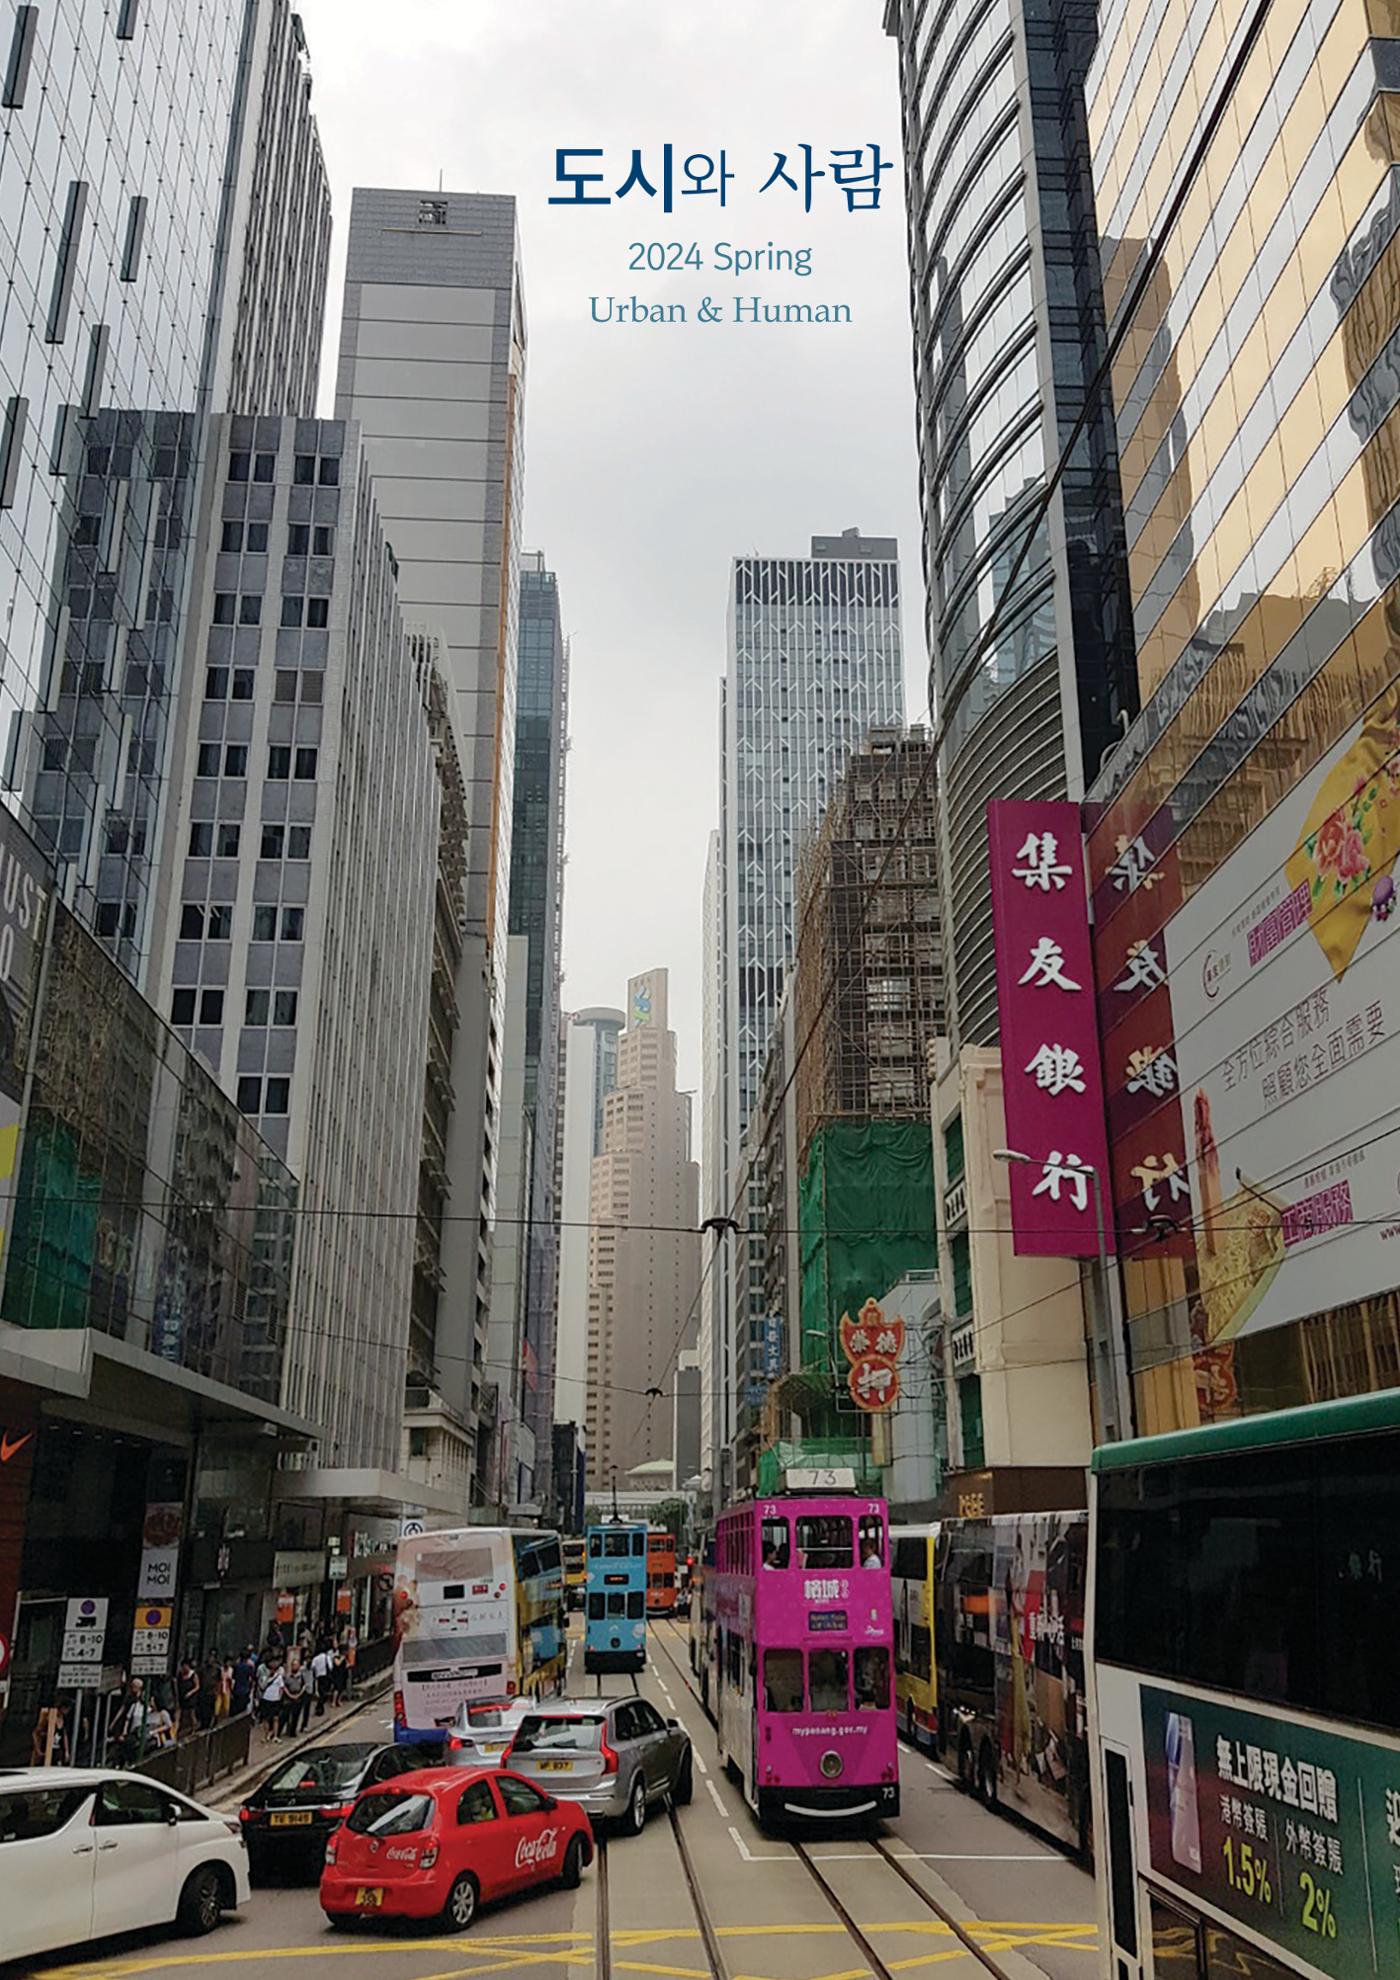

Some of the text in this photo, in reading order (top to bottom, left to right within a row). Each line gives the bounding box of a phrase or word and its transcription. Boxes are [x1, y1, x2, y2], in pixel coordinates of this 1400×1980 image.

[0, 843, 48, 940] UST
[1012, 832, 1094, 1211] 集友銀行
[1222, 988, 1330, 1092] 全方位綜合服務
[763, 1505, 776, 1514] 73
[808, 1470, 837, 1485] 73
[868, 1504, 880, 1513] 73
[882, 1787, 895, 1799] 73
[1216, 1734, 1338, 1823] 無上限現金回贈
[1223, 1836, 1272, 1903] 1.5%
[1300, 1872, 1337, 1938] 2%
